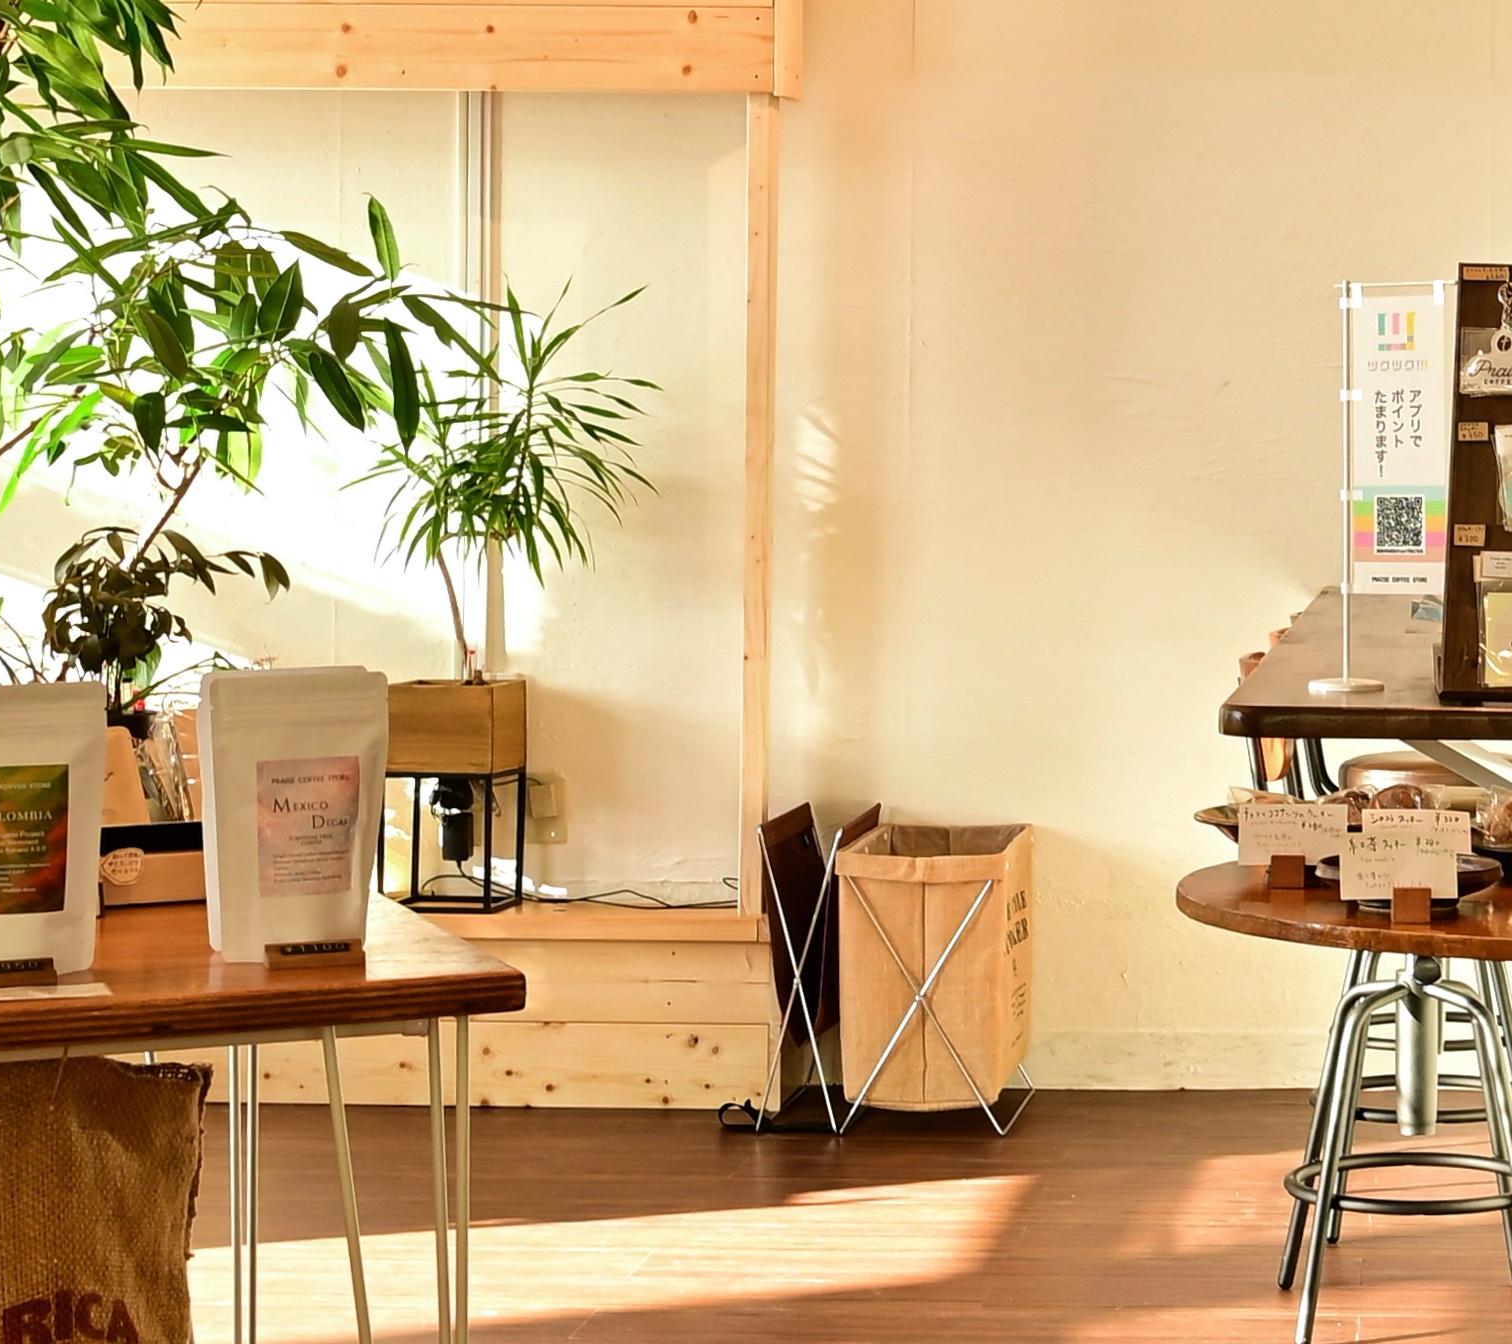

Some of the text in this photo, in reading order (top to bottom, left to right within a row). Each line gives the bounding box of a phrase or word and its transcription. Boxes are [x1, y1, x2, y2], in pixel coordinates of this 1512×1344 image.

[1373, 388, 1389, 479] たまります!
[1390, 388, 1406, 450] ポイント
[1408, 388, 1423, 449] アプリで
[272, 797, 329, 814] MEXICO
